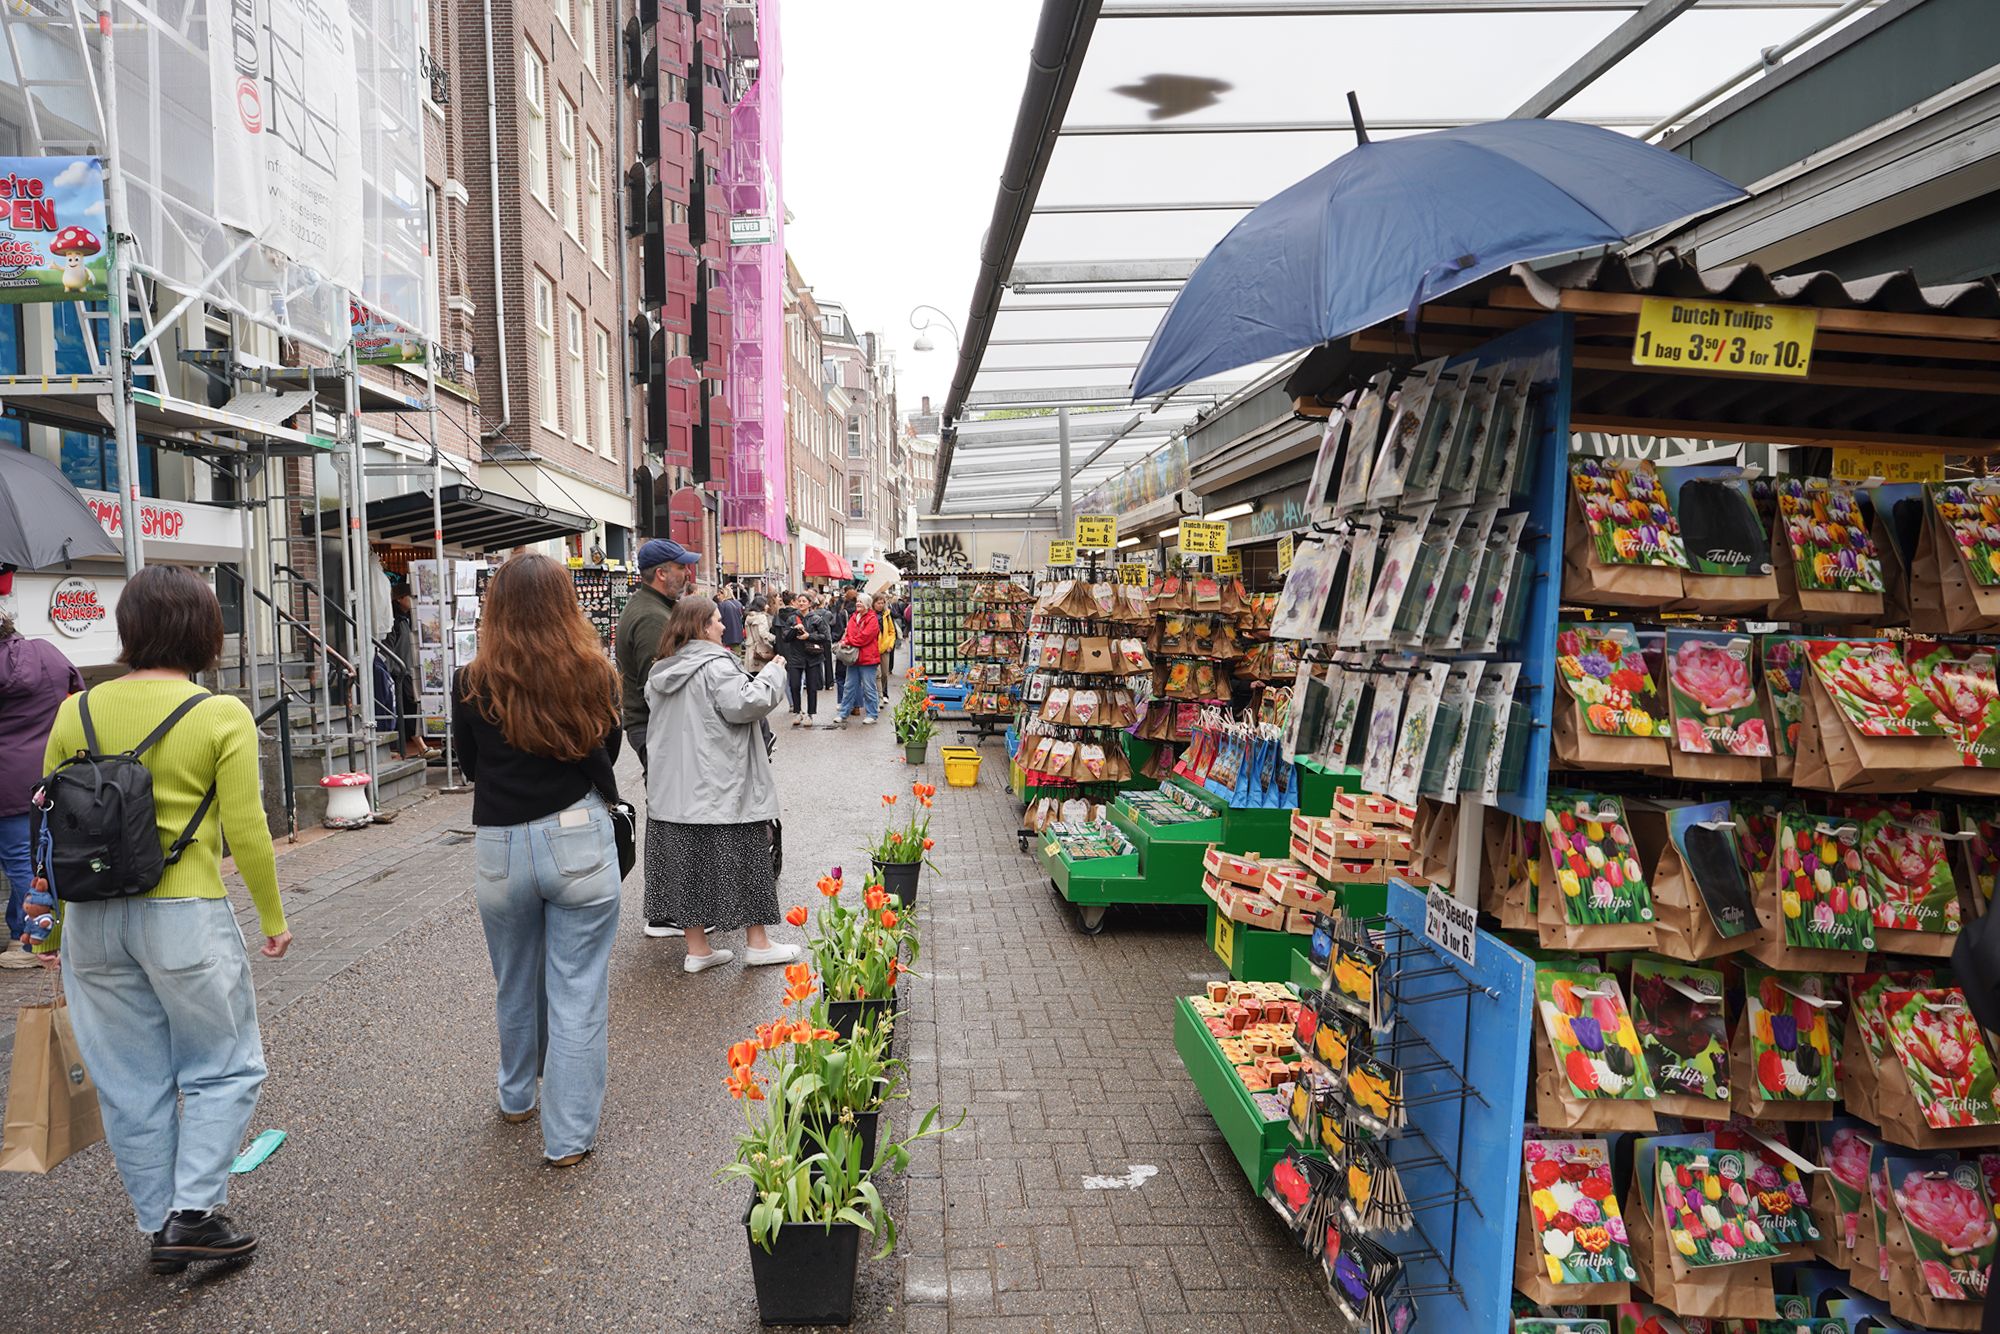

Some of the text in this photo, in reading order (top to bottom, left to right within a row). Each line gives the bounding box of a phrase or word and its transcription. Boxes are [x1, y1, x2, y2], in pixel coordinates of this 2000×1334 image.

[733, 222, 760, 232] WEVER
[1671, 305, 1774, 331] Dutch Tulips
[1640, 331, 1652, 357] 1
[1655, 344, 1682, 361] bag
[1729, 337, 1746, 364] 3
[1749, 350, 1769, 366] for
[1620, 538, 1668, 557] Tulips
[1706, 549, 1752, 567] Tulips
[1820, 563, 1866, 582] Tulips
[57, 591, 98, 606] MAGIC
[50, 606, 106, 621] MUSHROOM
[1605, 709, 1649, 729] Tulips
[1886, 716, 1931, 733] Tulips
[1701, 726, 1747, 746] Tulips
[1955, 739, 1997, 759] Tulips
[1588, 894, 1633, 914] Tulips
[1896, 901, 1940, 922] Tulips
[1445, 898, 1474, 934] Seeds
[1721, 906, 1745, 925] Tulips
[1442, 921, 1449, 946] 3
[1449, 932, 1461, 953] for
[1807, 919, 1854, 940] Tulips
[1590, 1071, 1633, 1088] Tulips
[1660, 1064, 1709, 1086] Tulips
[1778, 1072, 1818, 1089] Tulips
[1945, 1097, 1989, 1116] Tulips
[1758, 1214, 1798, 1233] Tulips
[1568, 1252, 1615, 1272] Tulips
[1949, 1269, 1990, 1291] Tulip
